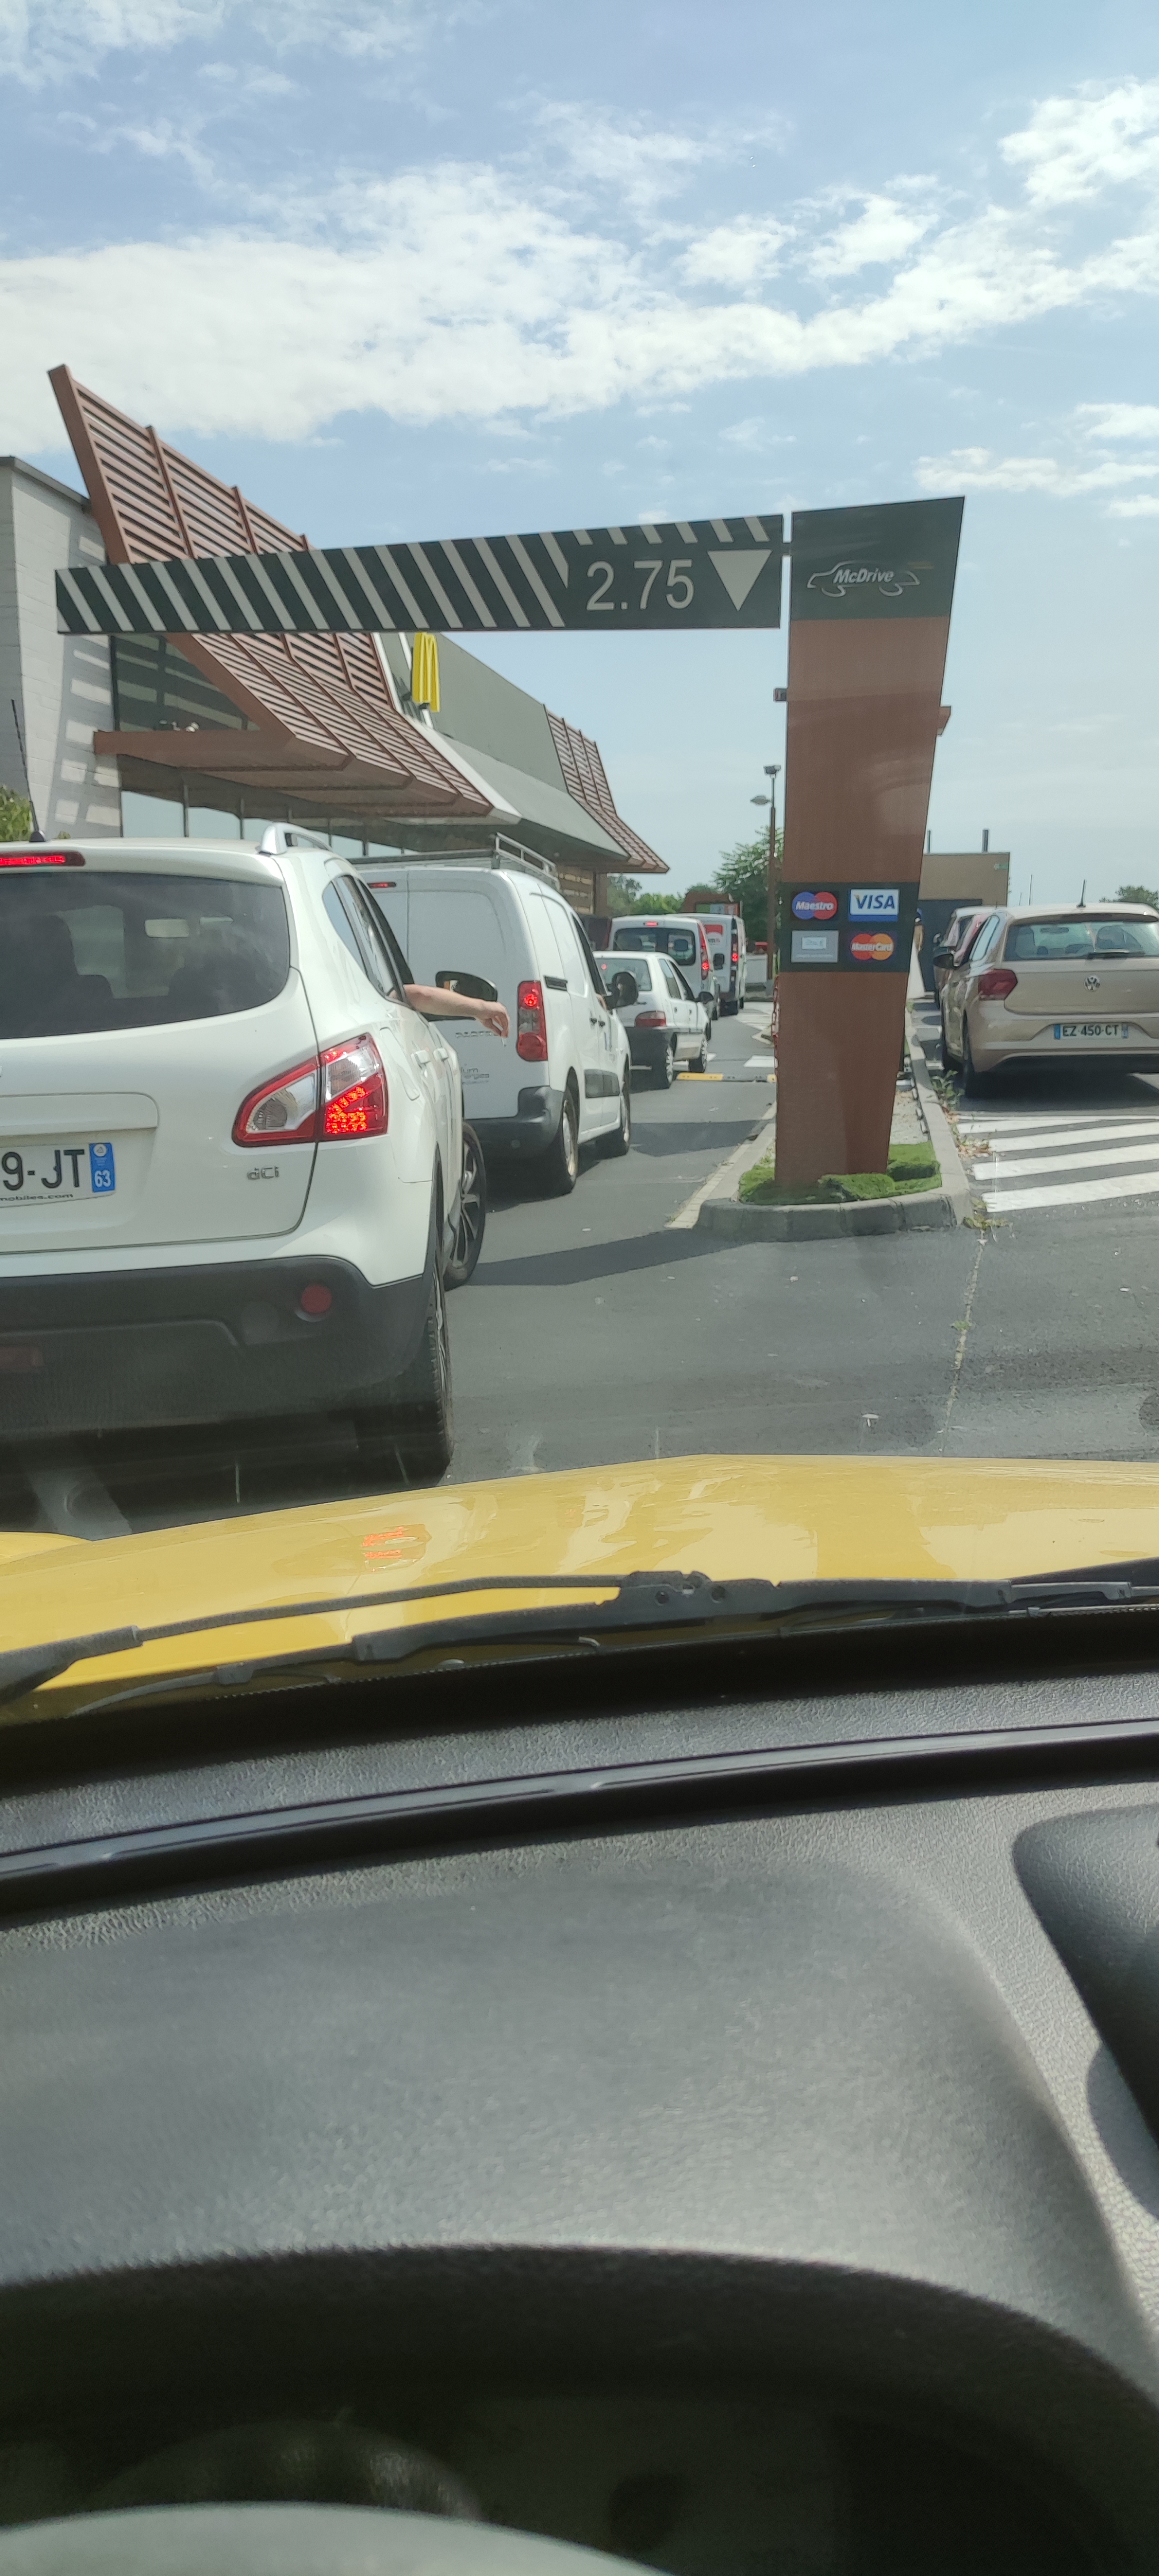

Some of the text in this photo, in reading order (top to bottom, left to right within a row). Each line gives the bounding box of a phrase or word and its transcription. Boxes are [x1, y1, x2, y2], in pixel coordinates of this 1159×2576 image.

[834, 568, 895, 584] McDrive
[586, 559, 694, 611] 2.75
[796, 900, 834, 911] Maestro
[854, 895, 895, 910] VISA
[1, 1149, 86, 1191] 9-JT
[247, 1165, 280, 1180] dCi
[94, 1169, 112, 1188] 63
